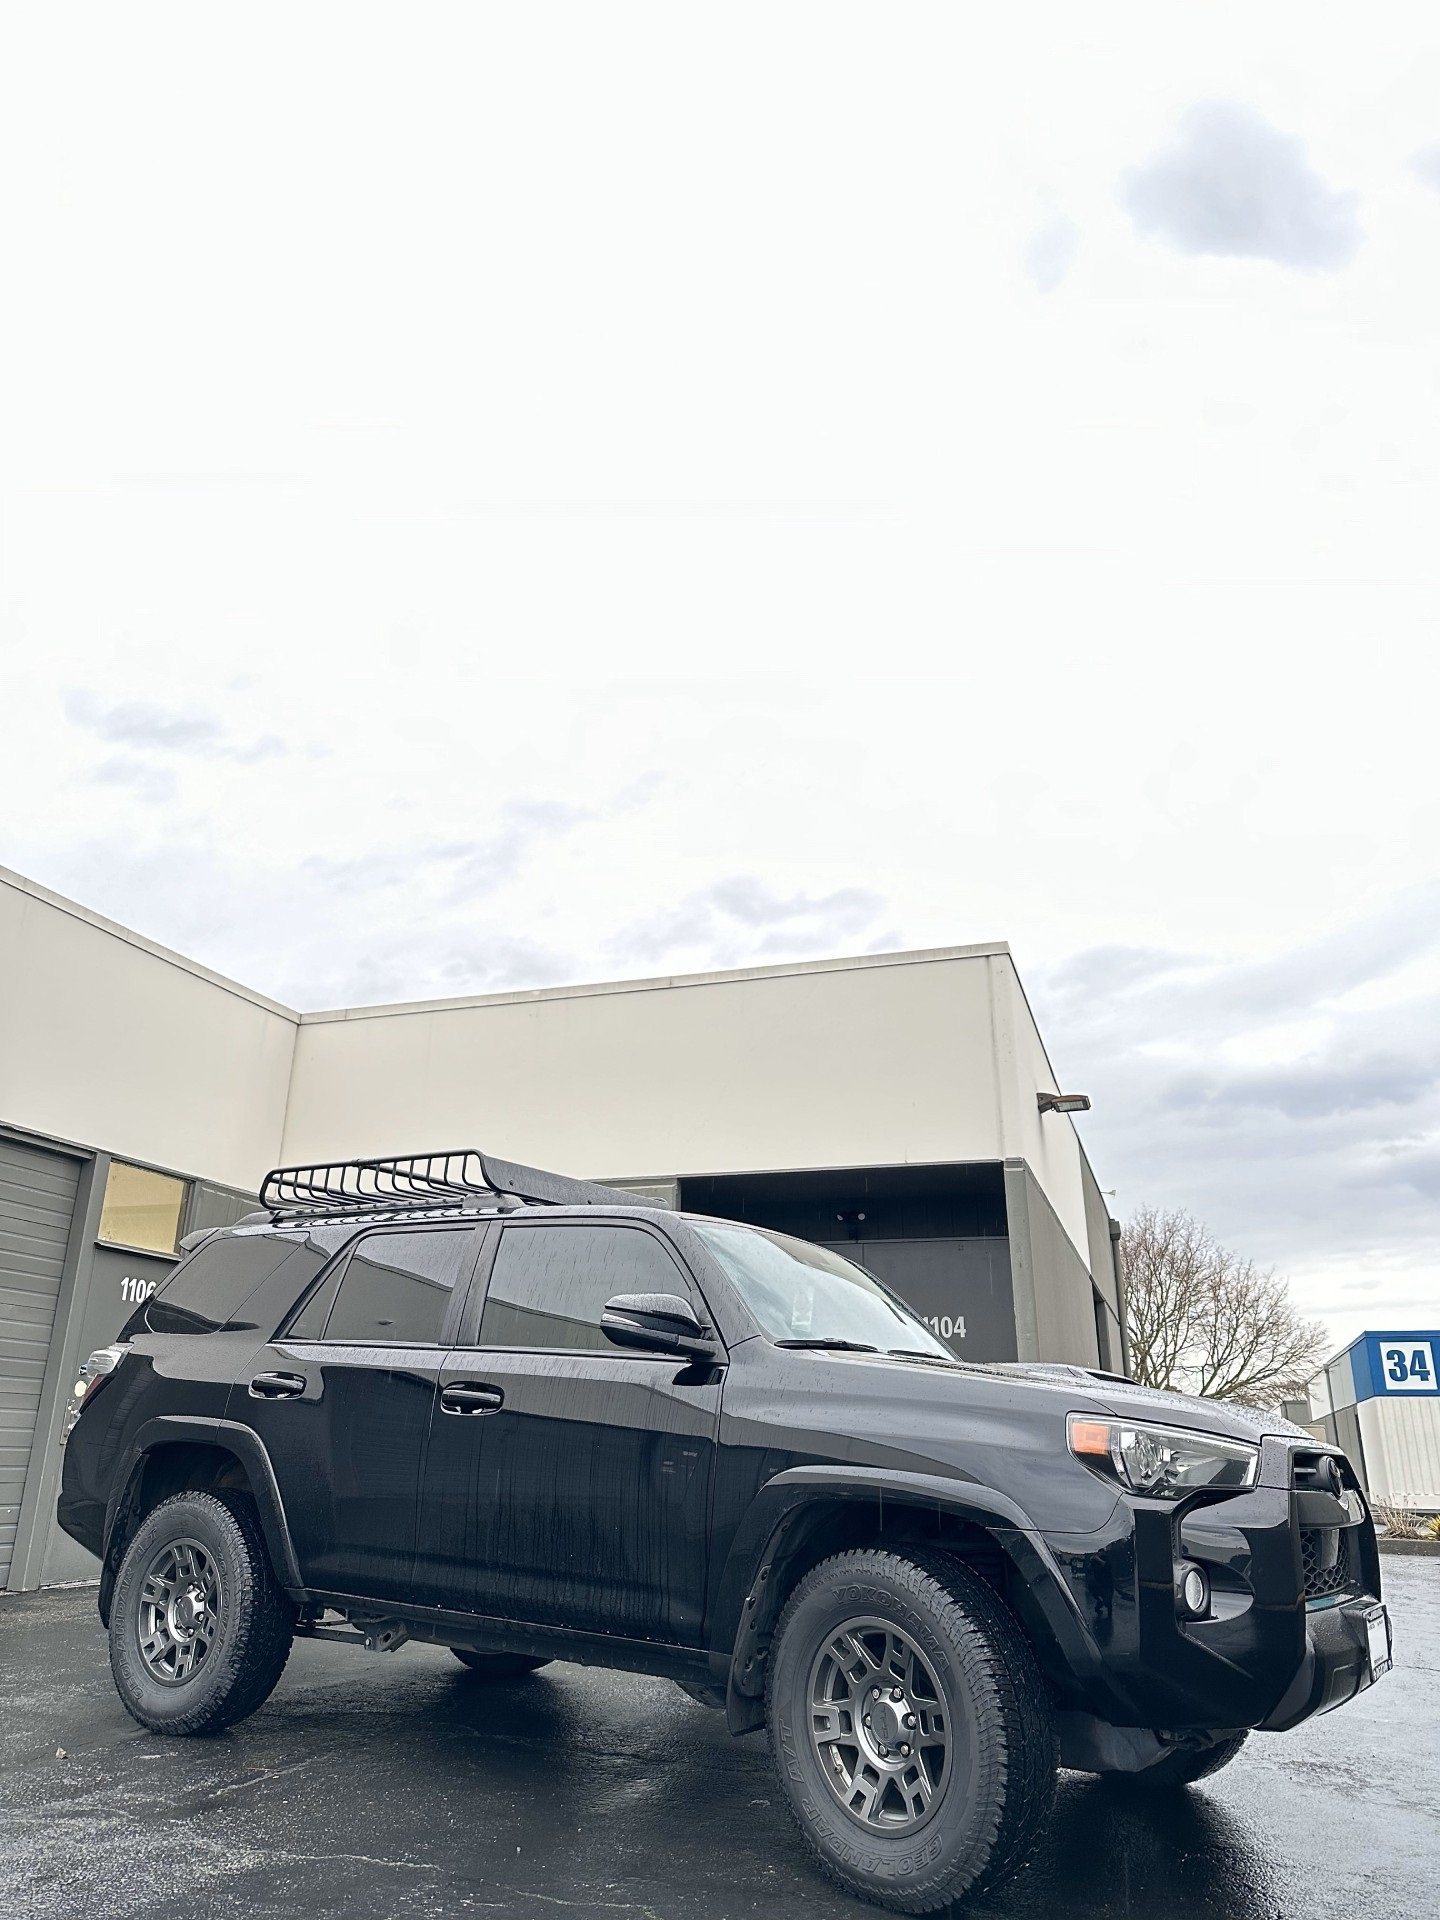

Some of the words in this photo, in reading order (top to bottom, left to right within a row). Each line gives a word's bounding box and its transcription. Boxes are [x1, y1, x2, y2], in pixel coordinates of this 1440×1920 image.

[922, 1316, 967, 1338] 104
[1386, 1349, 1431, 1382] 34
[830, 1584, 950, 1673] YOKOHAMA
[779, 1718, 805, 1784] A/T
[801, 1798, 943, 1876] GEOLANDAR
